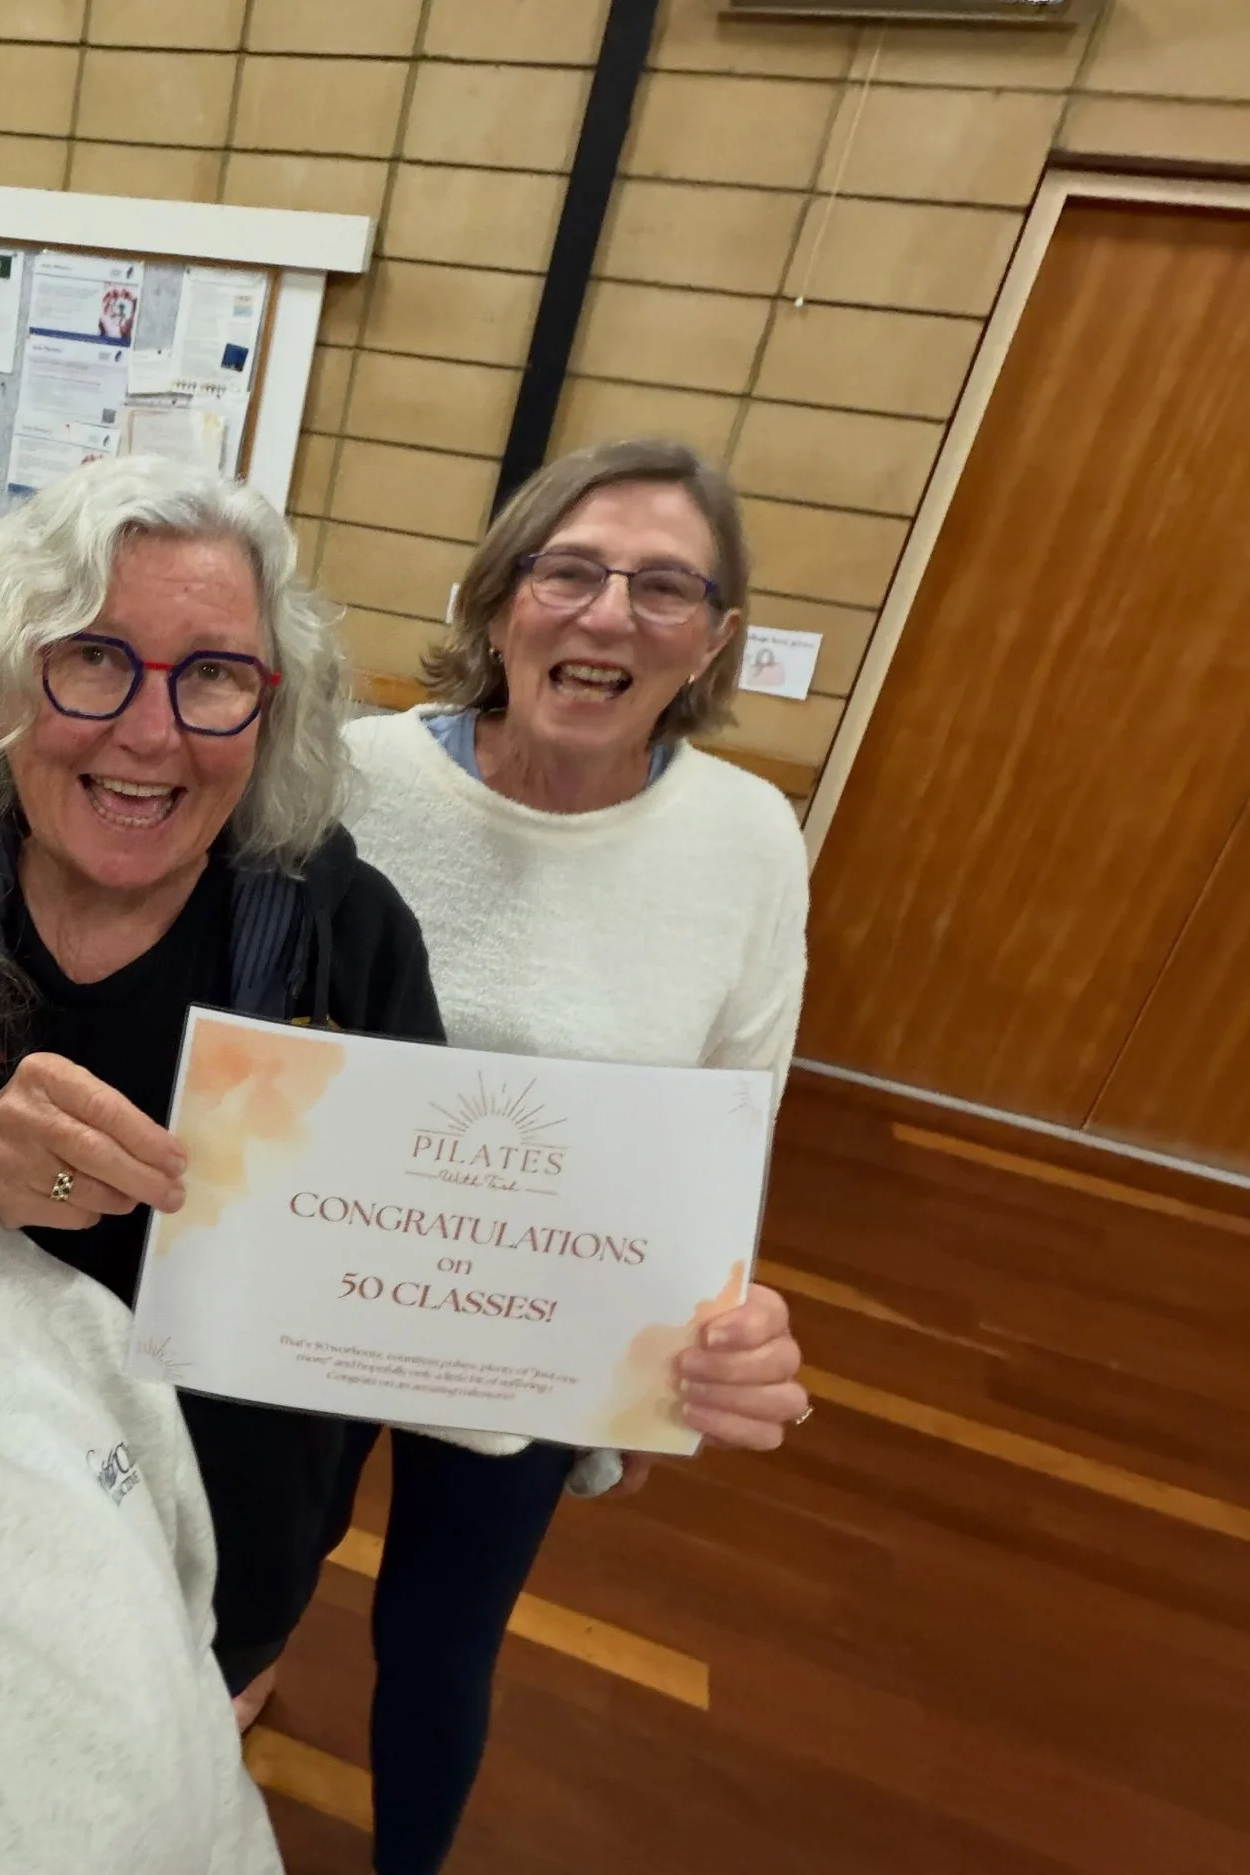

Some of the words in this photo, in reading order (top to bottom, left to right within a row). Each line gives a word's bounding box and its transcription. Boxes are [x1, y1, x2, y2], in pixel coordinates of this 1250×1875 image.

[412, 1134, 566, 1176] PILATES
[289, 1191, 649, 1266] CONGRATULATIONS
[436, 1256, 473, 1276] on
[337, 1271, 384, 1301] 50
[391, 1280, 558, 1323] CLASSES!
